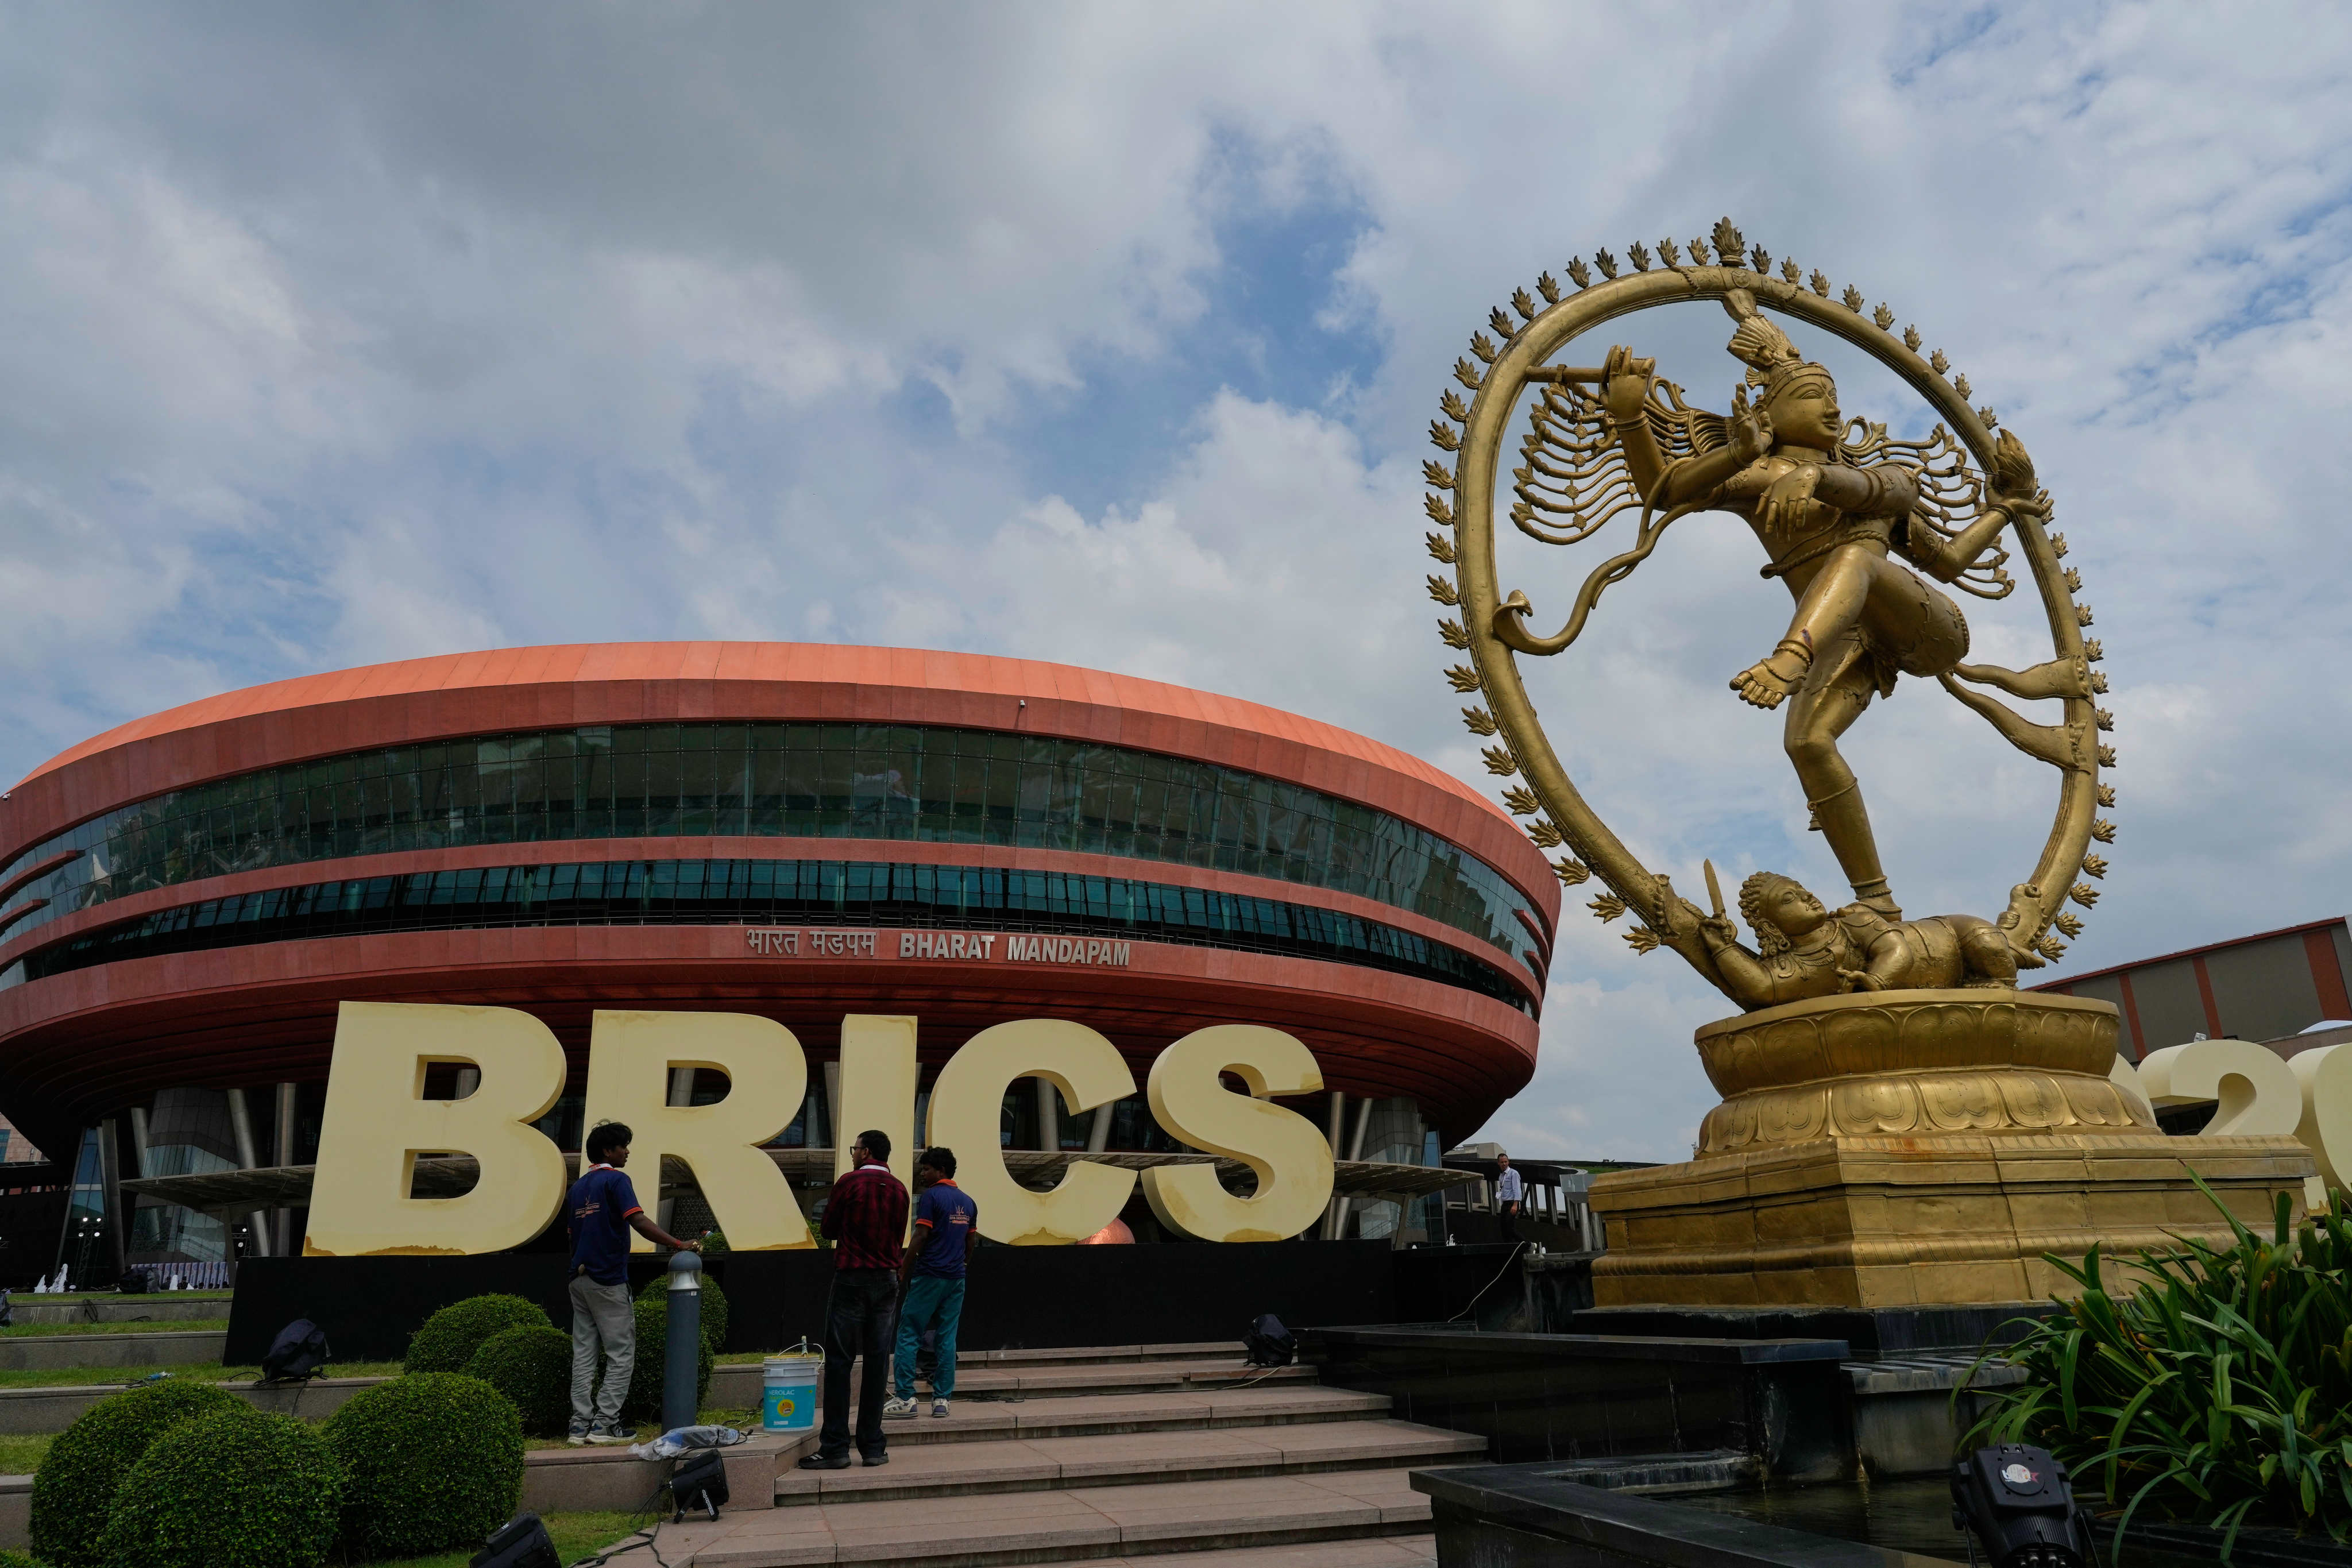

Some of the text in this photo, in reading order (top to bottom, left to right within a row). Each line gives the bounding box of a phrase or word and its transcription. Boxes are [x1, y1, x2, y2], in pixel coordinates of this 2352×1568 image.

[747, 929, 800, 955] भारत
[900, 933, 1130, 965] BHARAT MANDAPAM
[302, 1000, 1335, 1257] BRICS
